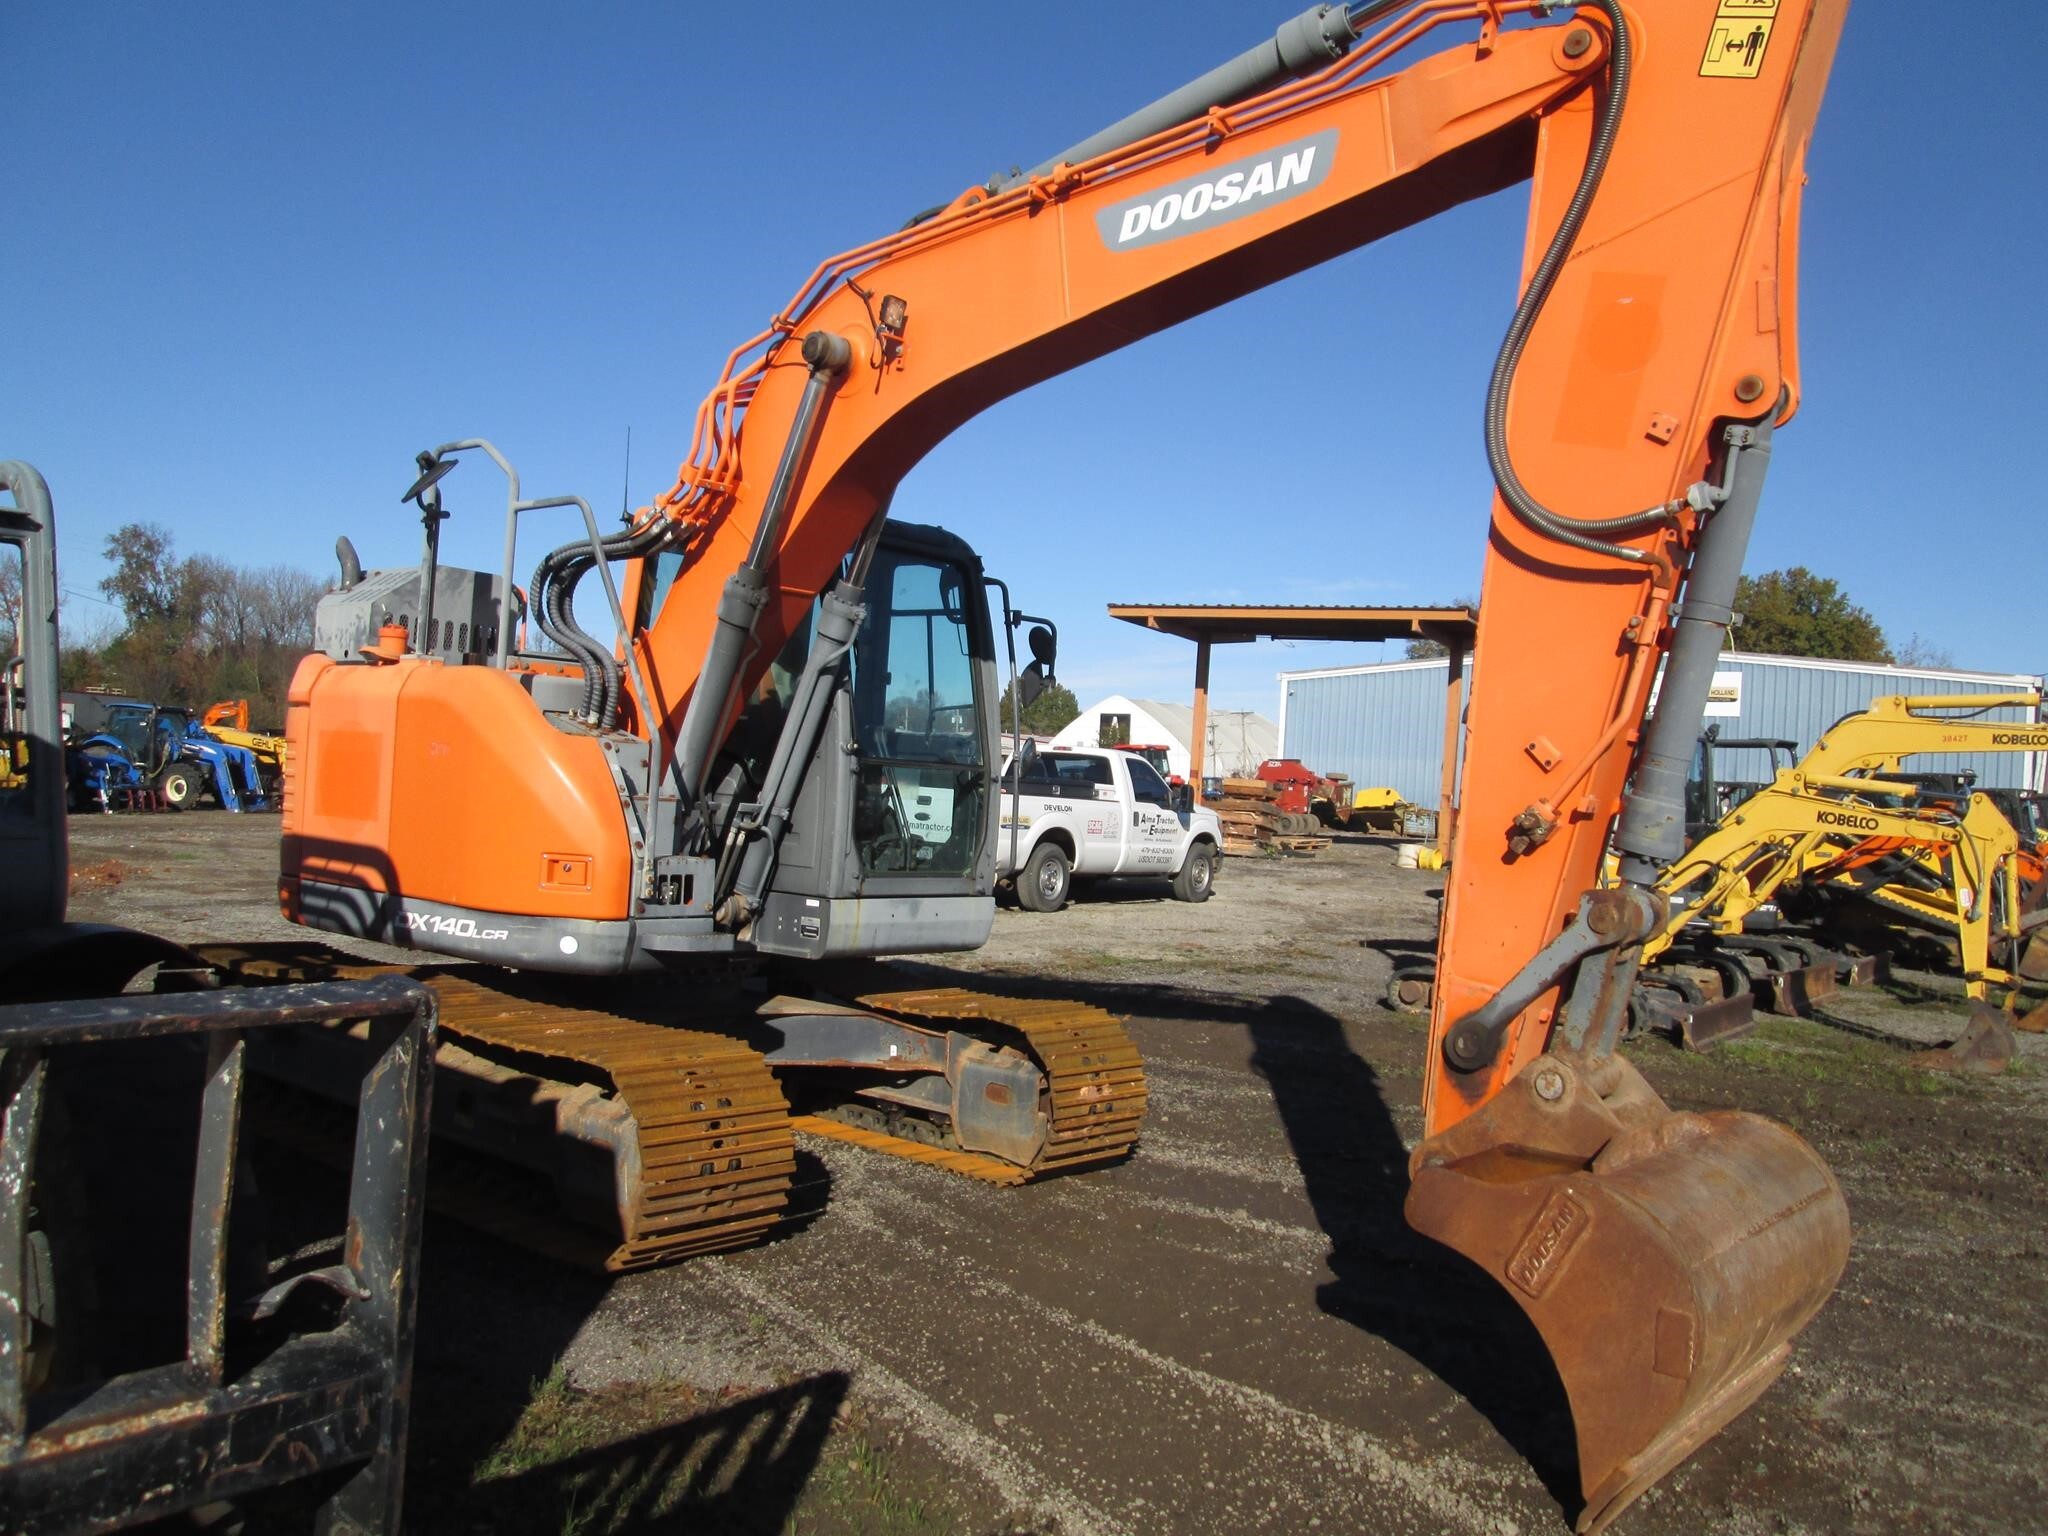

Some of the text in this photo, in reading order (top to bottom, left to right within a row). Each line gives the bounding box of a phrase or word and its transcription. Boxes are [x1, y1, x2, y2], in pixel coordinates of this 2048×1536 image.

[1118, 146, 1317, 244] DOOSAN
[252, 737, 271, 750] GEHL
[1992, 734, 2048, 746] KOBELCO
[1043, 804, 1073, 812] DEVELON
[1156, 814, 1176, 825] Tractor
[1816, 810, 1879, 831] KOBELCO
[1149, 824, 1179, 837] Equipment
[1519, 1203, 1574, 1286] DOOSAN
